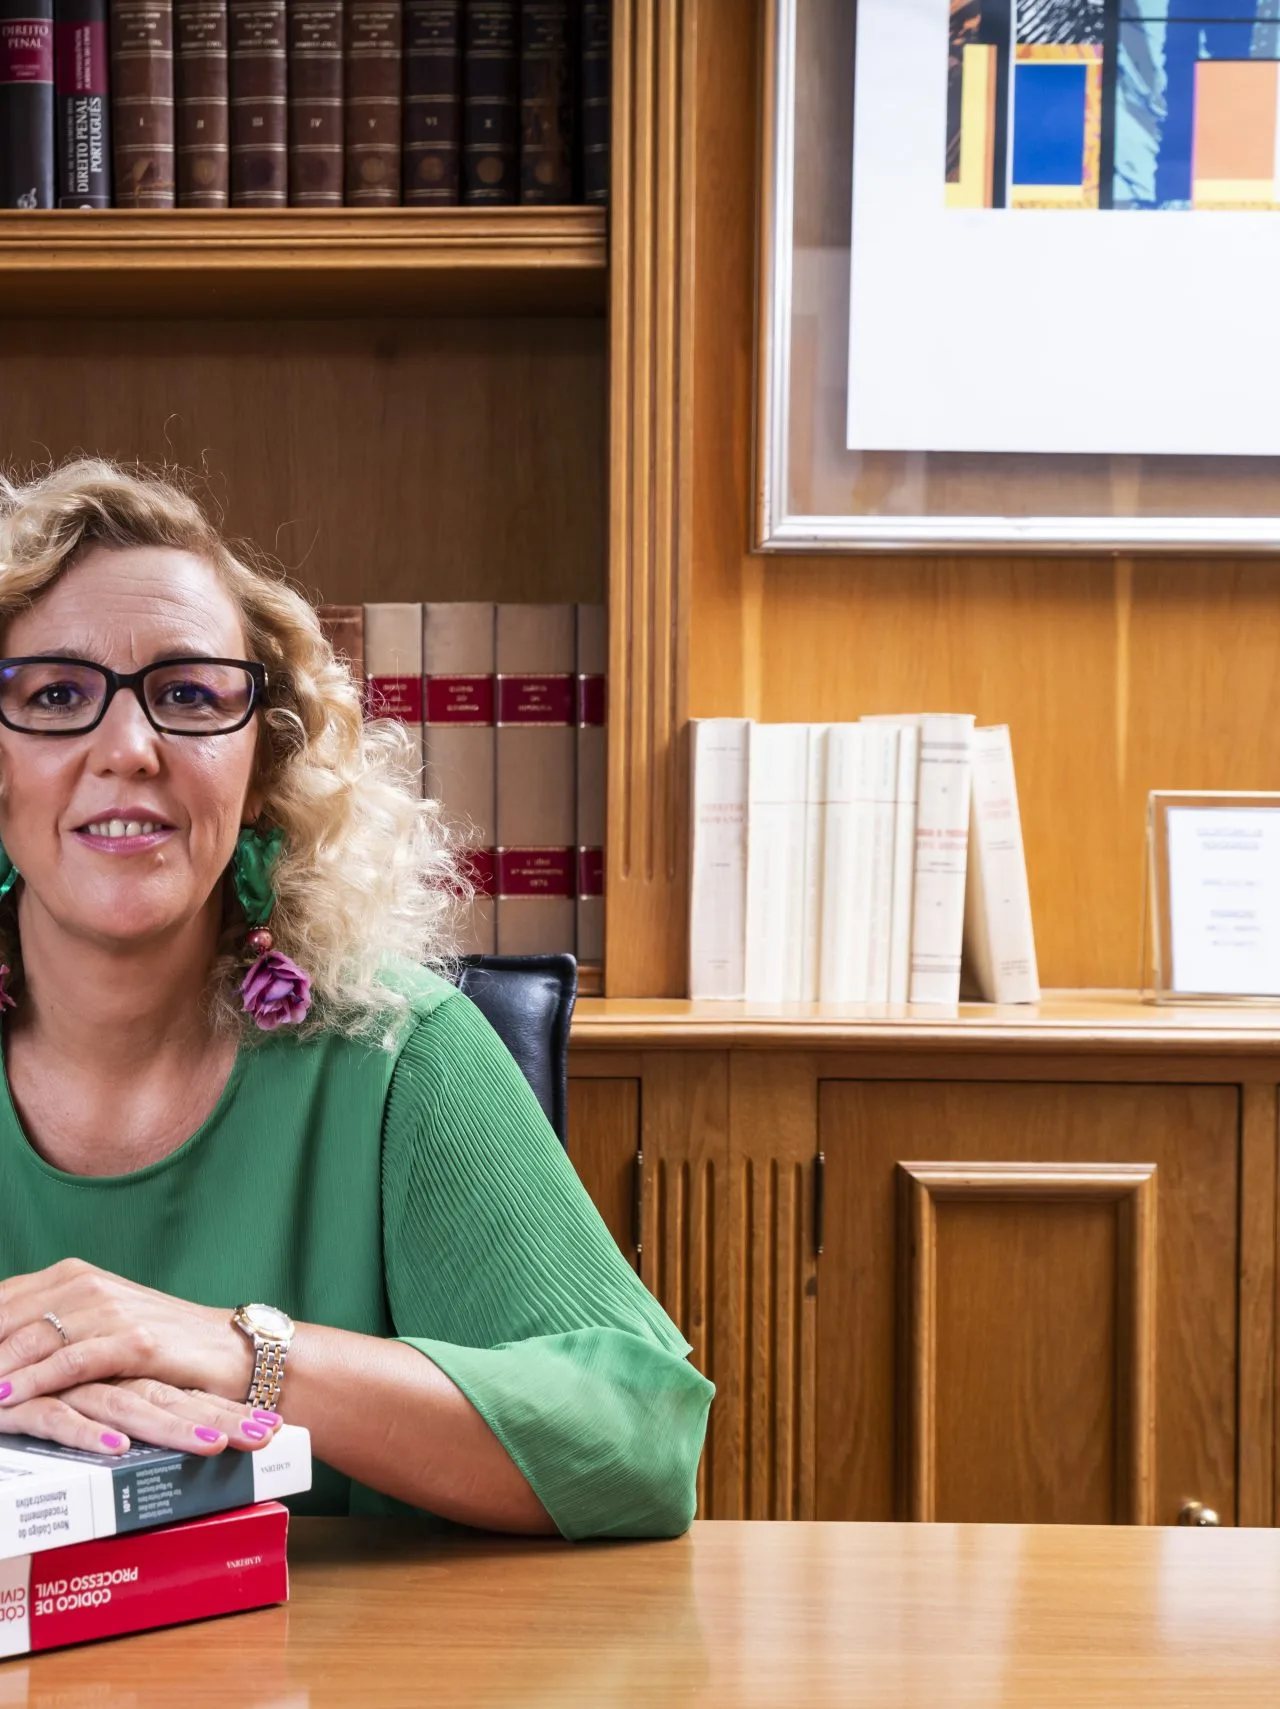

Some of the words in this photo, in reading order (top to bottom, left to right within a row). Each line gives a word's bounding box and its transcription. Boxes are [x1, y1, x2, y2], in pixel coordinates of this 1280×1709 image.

[2, 25, 49, 36] DIREITO
[8, 38, 44, 49] PENAL
[75, 96, 89, 140] PENAL
[87, 96, 103, 173] PORTUGUÊS
[76, 142, 90, 193] DIREITO
[15, 1490, 67, 1508] Administrativo
[19, 1505, 69, 1523] Procedimento
[18, 1528, 27, 1539] do
[27, 1523, 52, 1537] Código
[52, 1520, 70, 1531] Novo
[226, 1555, 262, 1569] ALMEDINA
[70, 1566, 140, 1592] PROCESSO
[35, 1582, 68, 1598] CIVIL
[56, 1588, 112, 1612] CÓDIGO
[35, 1602, 54, 1616] DE
